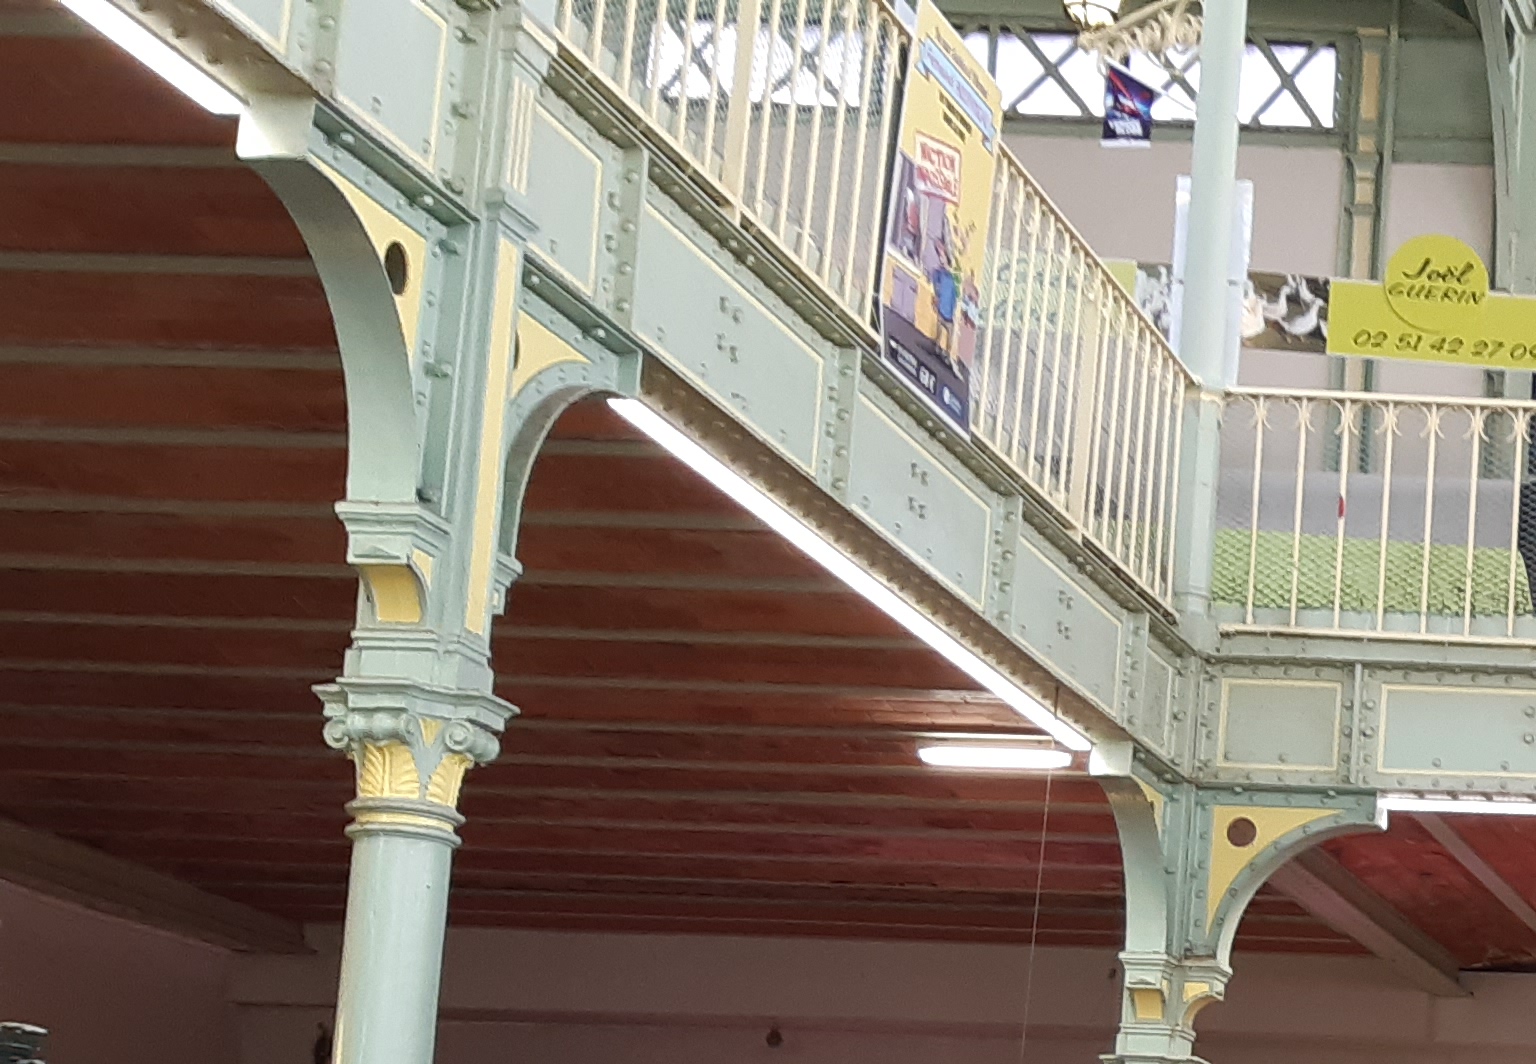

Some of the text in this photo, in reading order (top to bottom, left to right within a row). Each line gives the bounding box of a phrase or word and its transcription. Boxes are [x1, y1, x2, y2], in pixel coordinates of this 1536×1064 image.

[1353, 329, 1388, 349] 02
[1395, 332, 1423, 352] 51
[1429, 336, 1465, 355] 42
[1471, 339, 1506, 359] 27
